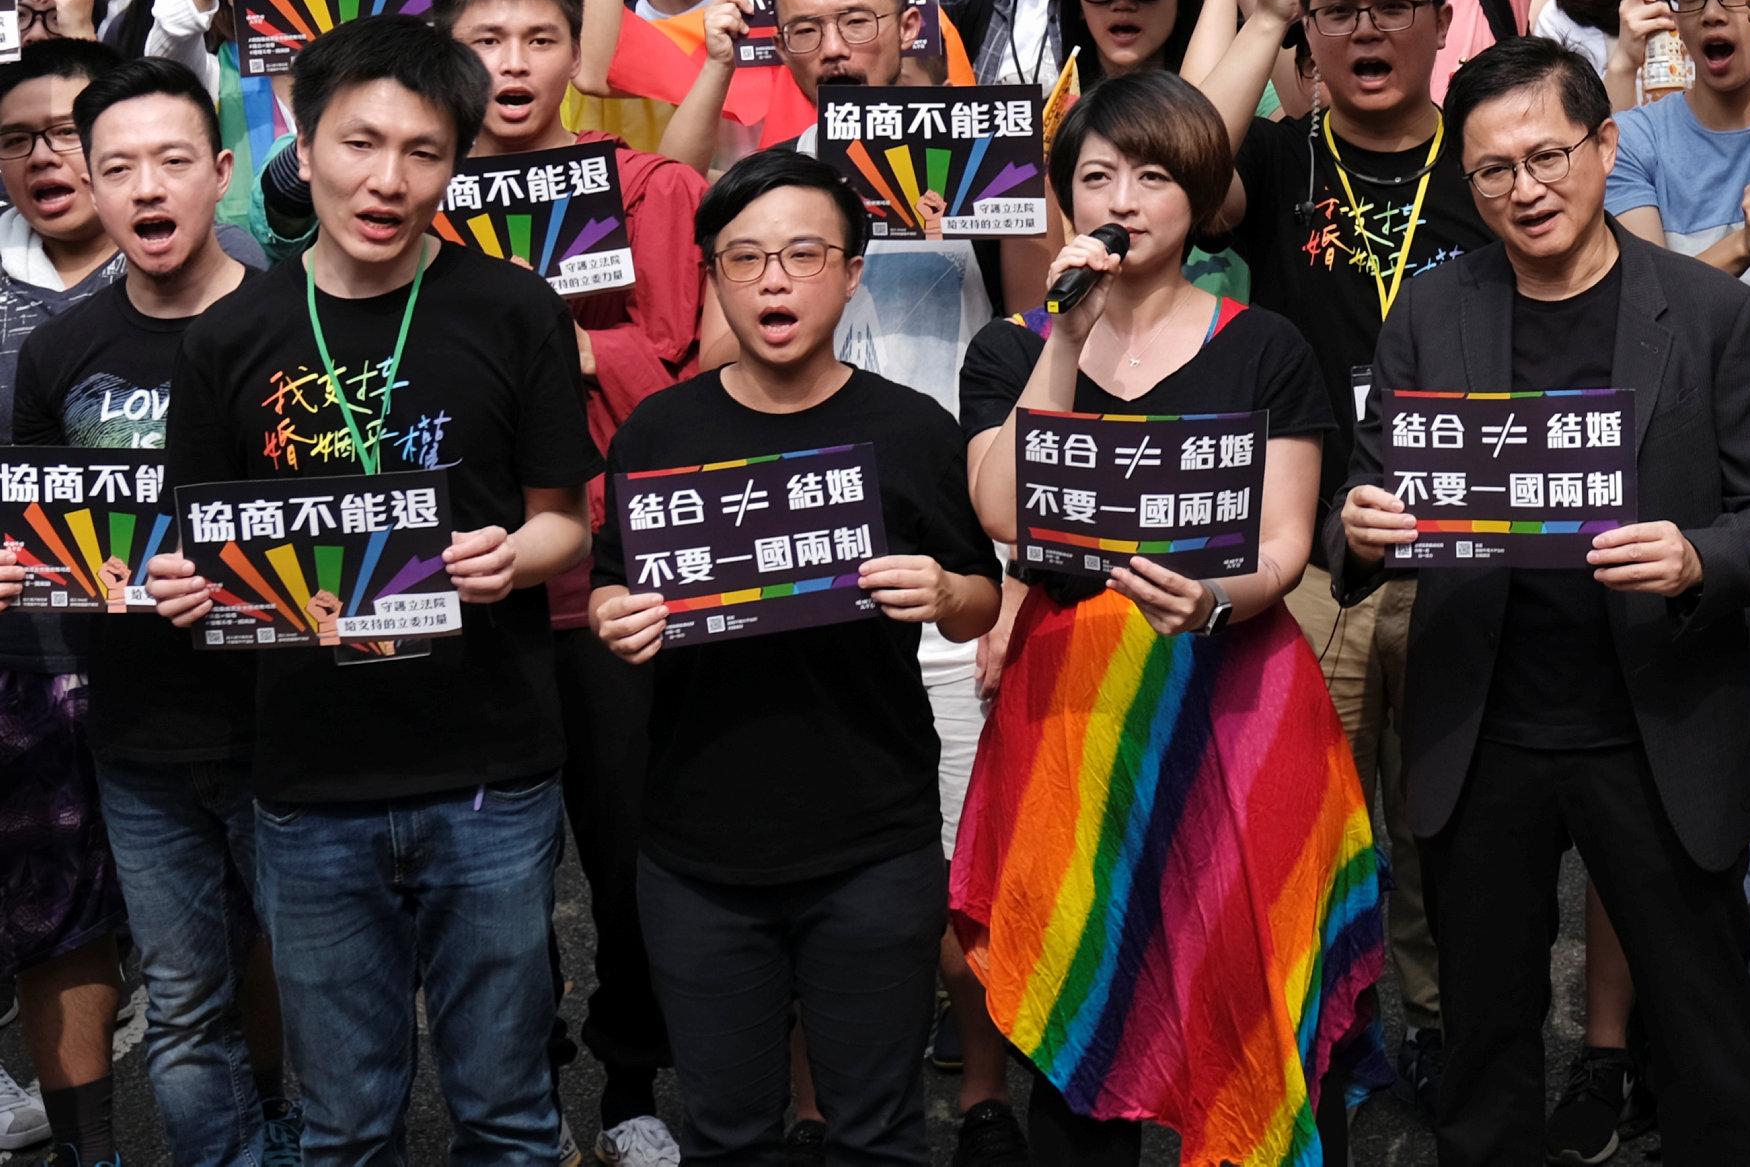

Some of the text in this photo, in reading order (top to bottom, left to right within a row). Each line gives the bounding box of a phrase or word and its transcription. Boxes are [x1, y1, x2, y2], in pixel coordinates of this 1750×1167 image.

[824, 100, 1034, 141] 協商不能退
[441, 156, 611, 211] 商不能退
[978, 202, 1035, 215] 守護立法院
[101, 388, 167, 421] LOV
[1024, 429, 1098, 469] 結合
[1180, 431, 1255, 471] 結婚
[1392, 412, 1464, 449] 結合
[1547, 410, 1622, 447] 結婚
[629, 488, 704, 532] 結合
[787, 467, 865, 512] 結婚
[1025, 484, 1251, 528] 不要一國兩制
[1392, 470, 1622, 508] 不要一國兩制
[188, 488, 439, 542] 協商不能退
[635, 525, 873, 588] 不要一國兩制
[344, 616, 448, 631] 給支持的立委力量
[381, 598, 445, 613] 守護立法院
